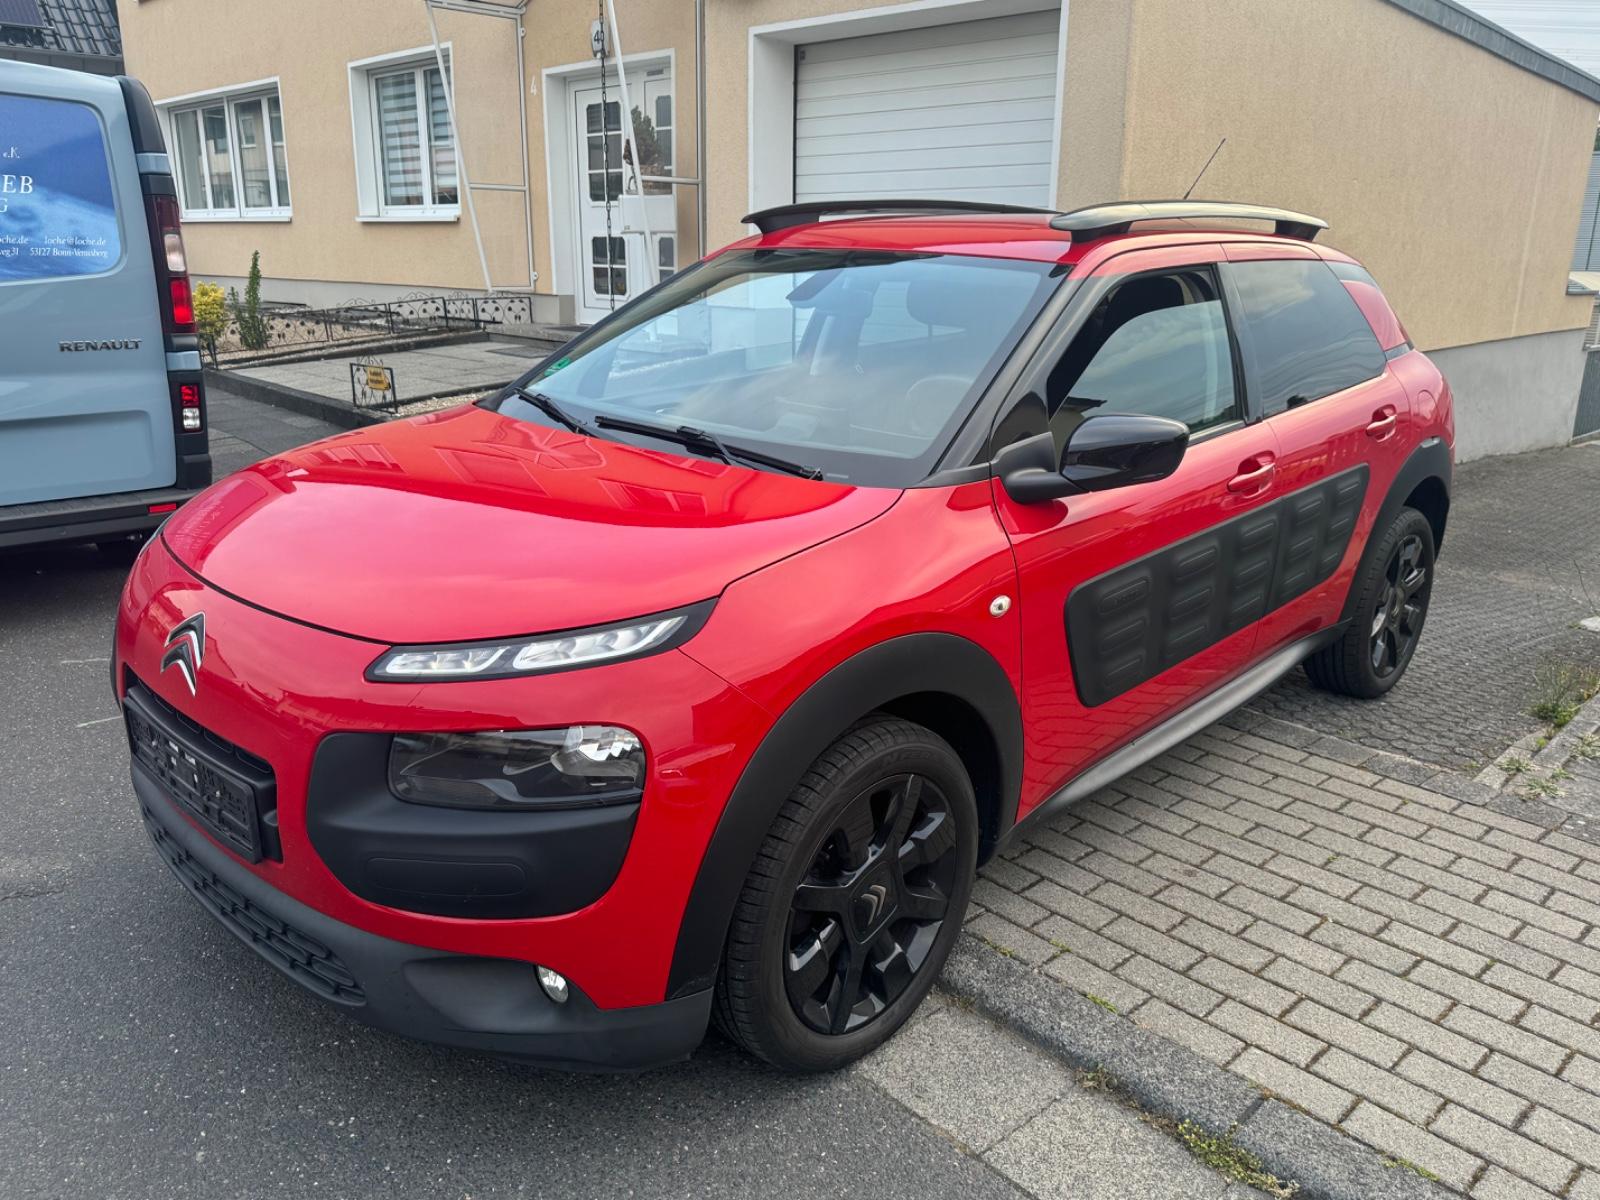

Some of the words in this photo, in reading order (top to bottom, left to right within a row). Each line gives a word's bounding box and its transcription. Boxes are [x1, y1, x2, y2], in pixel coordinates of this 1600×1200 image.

[530, 75, 537, 96] 4
[30, 247, 51, 257] 53127
[58, 339, 142, 352] RENAULT
